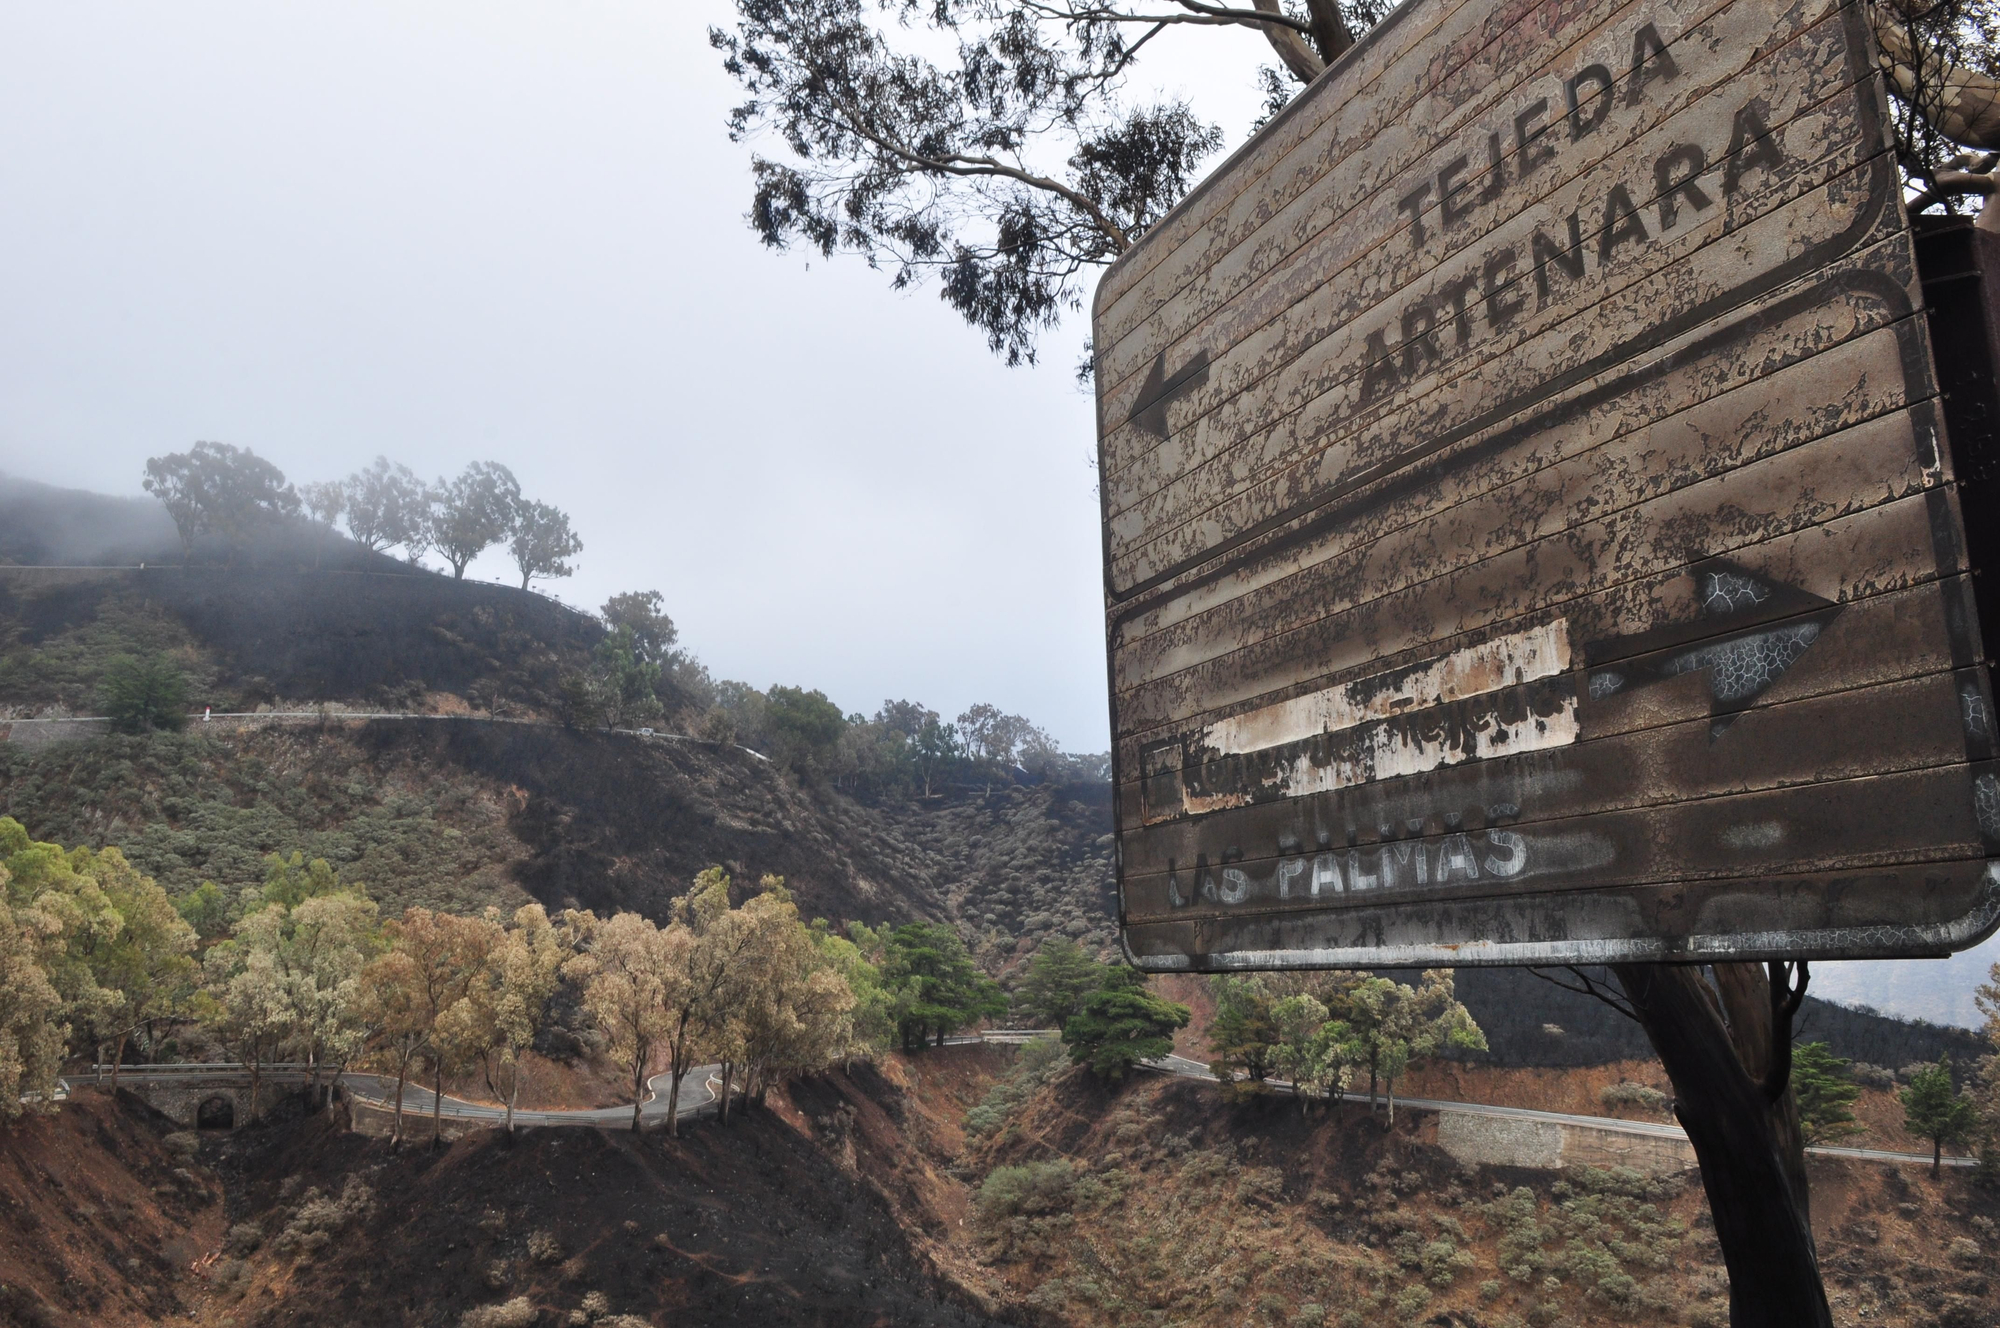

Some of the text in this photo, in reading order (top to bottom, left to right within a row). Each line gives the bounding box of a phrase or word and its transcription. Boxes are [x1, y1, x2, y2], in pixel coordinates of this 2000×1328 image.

[1360, 98, 1785, 400] ARTENARA
[1397, 21, 1680, 249] TEJEDA
[1168, 803, 1528, 907] LAS PALMAS
